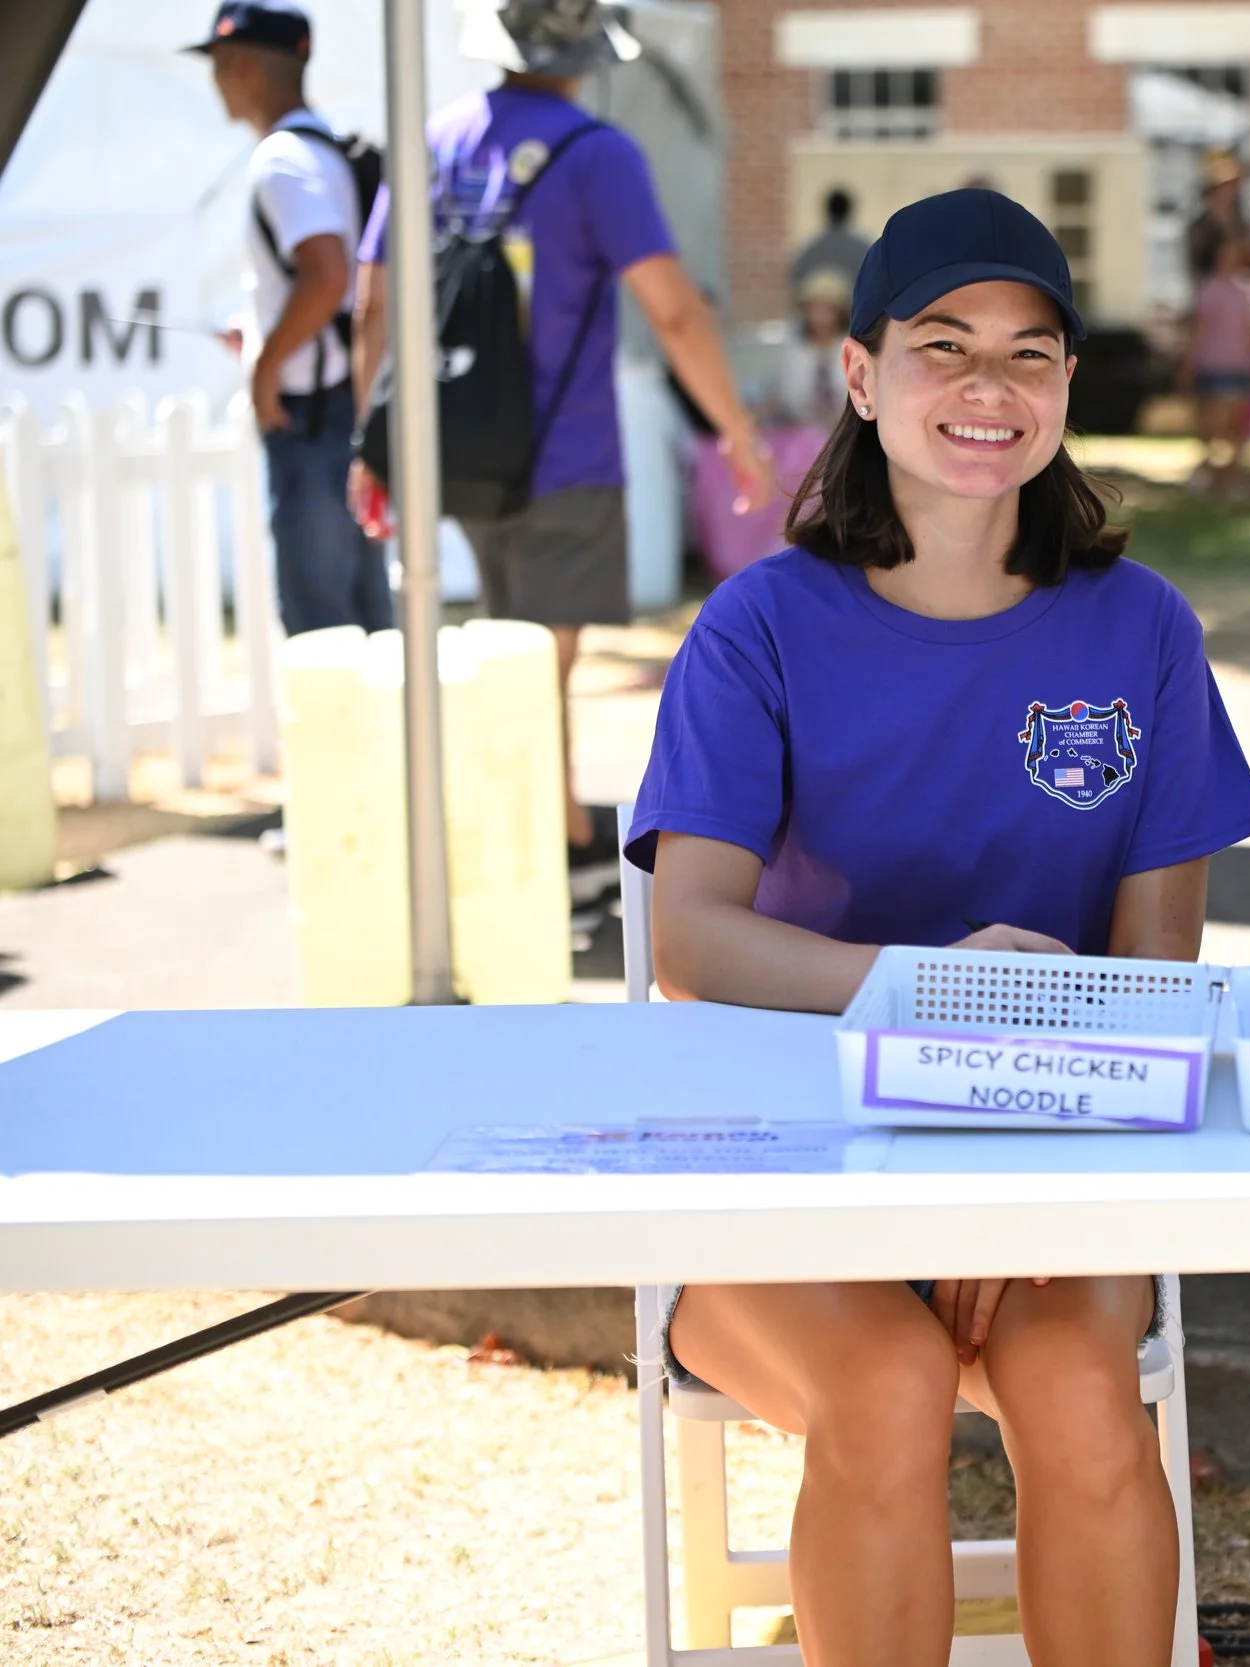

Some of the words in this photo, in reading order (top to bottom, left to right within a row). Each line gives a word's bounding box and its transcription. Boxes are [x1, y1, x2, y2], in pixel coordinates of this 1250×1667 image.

[1052, 724, 1080, 732] HAWAII
[1080, 723, 1109, 731] KOREAN
[1064, 731, 1098, 739] CHAMBER
[1058, 738, 1066, 746] of
[1066, 738, 1104, 746] COMMERCE
[1077, 790, 1093, 798] 1940
[918, 1045, 1004, 1071] SPICY
[1013, 1052, 1150, 1082] CHICKEN
[968, 1085, 1093, 1115] NOODLE
